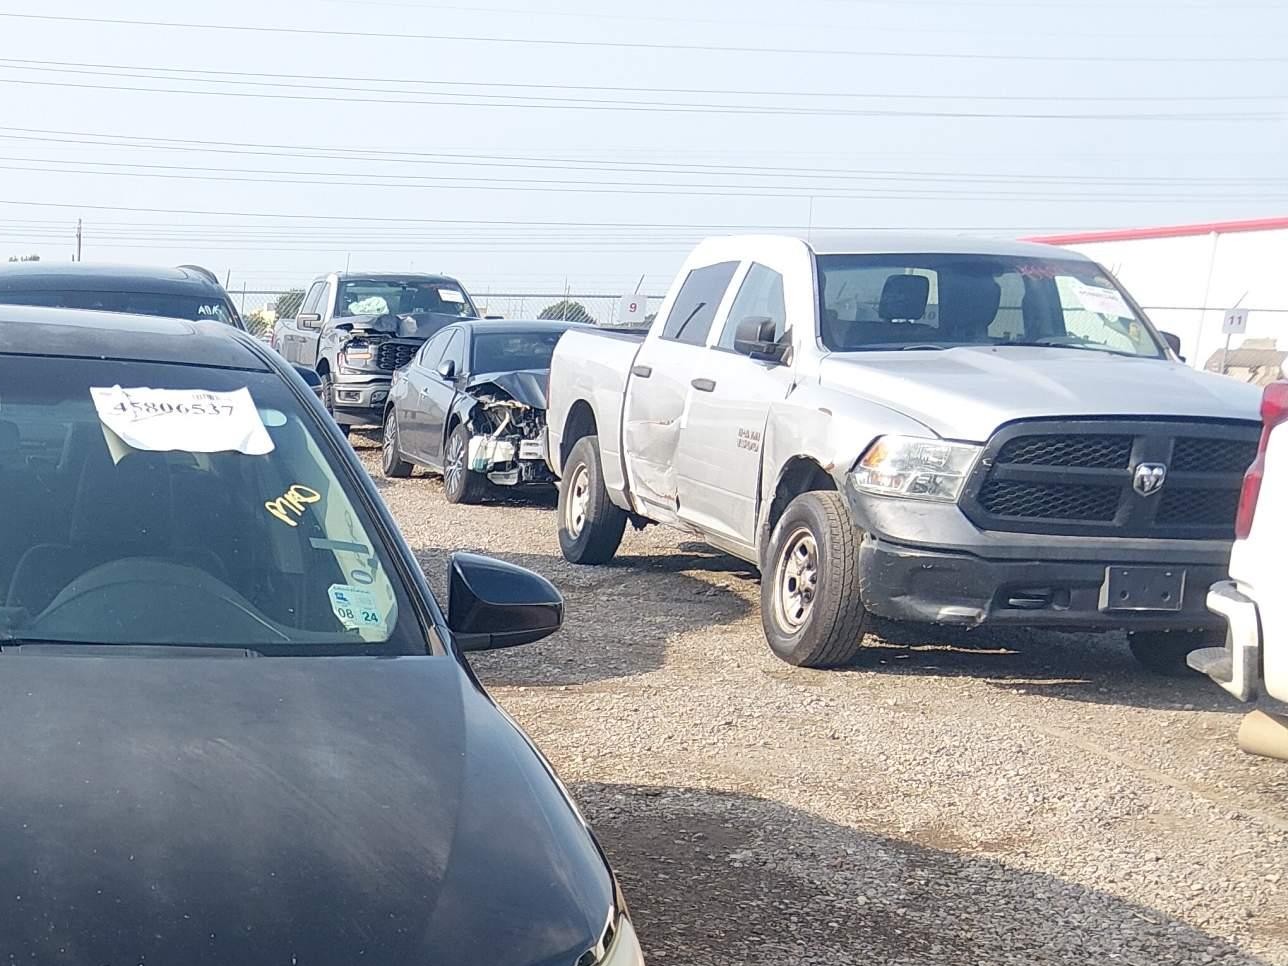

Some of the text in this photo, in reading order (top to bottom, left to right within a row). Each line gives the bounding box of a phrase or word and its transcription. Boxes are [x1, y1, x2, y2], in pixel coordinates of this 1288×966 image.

[629, 303, 637, 313] 9
[1228, 315, 1242, 326] 11
[113, 401, 234, 417] 45806537
[738, 427, 761, 442] RAM
[337, 607, 379, 623] 08 24
